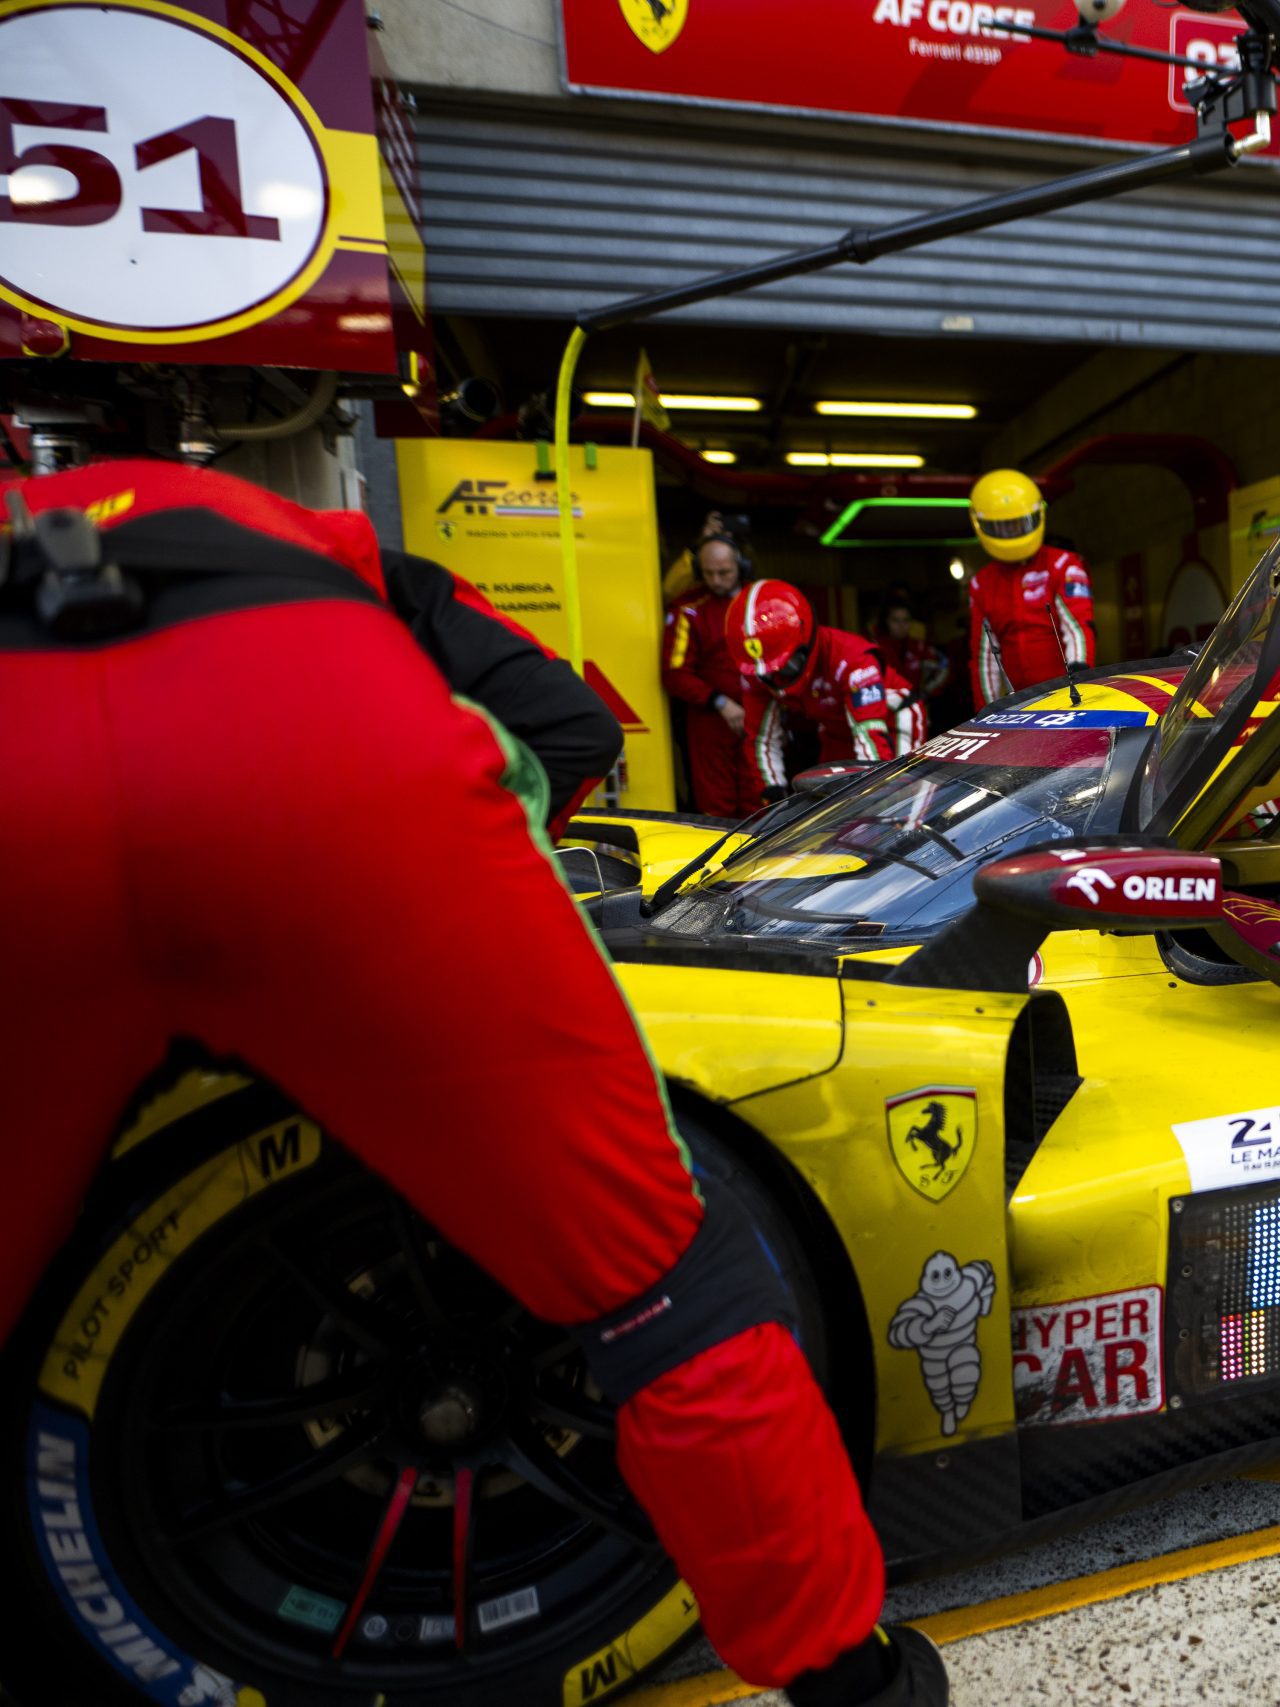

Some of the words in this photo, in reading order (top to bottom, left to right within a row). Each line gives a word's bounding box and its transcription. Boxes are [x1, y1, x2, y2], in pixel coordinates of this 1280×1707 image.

[872, 0, 924, 27] AF
[0, 97, 281, 242] 51
[1122, 875, 1216, 901] ORLEN
[257, 1125, 299, 1178] M
[1231, 1150, 1253, 1165] LE
[62, 1302, 111, 1381] PILOT
[107, 1208, 183, 1297] SPORT
[36, 1430, 183, 1683] MICHELIN
